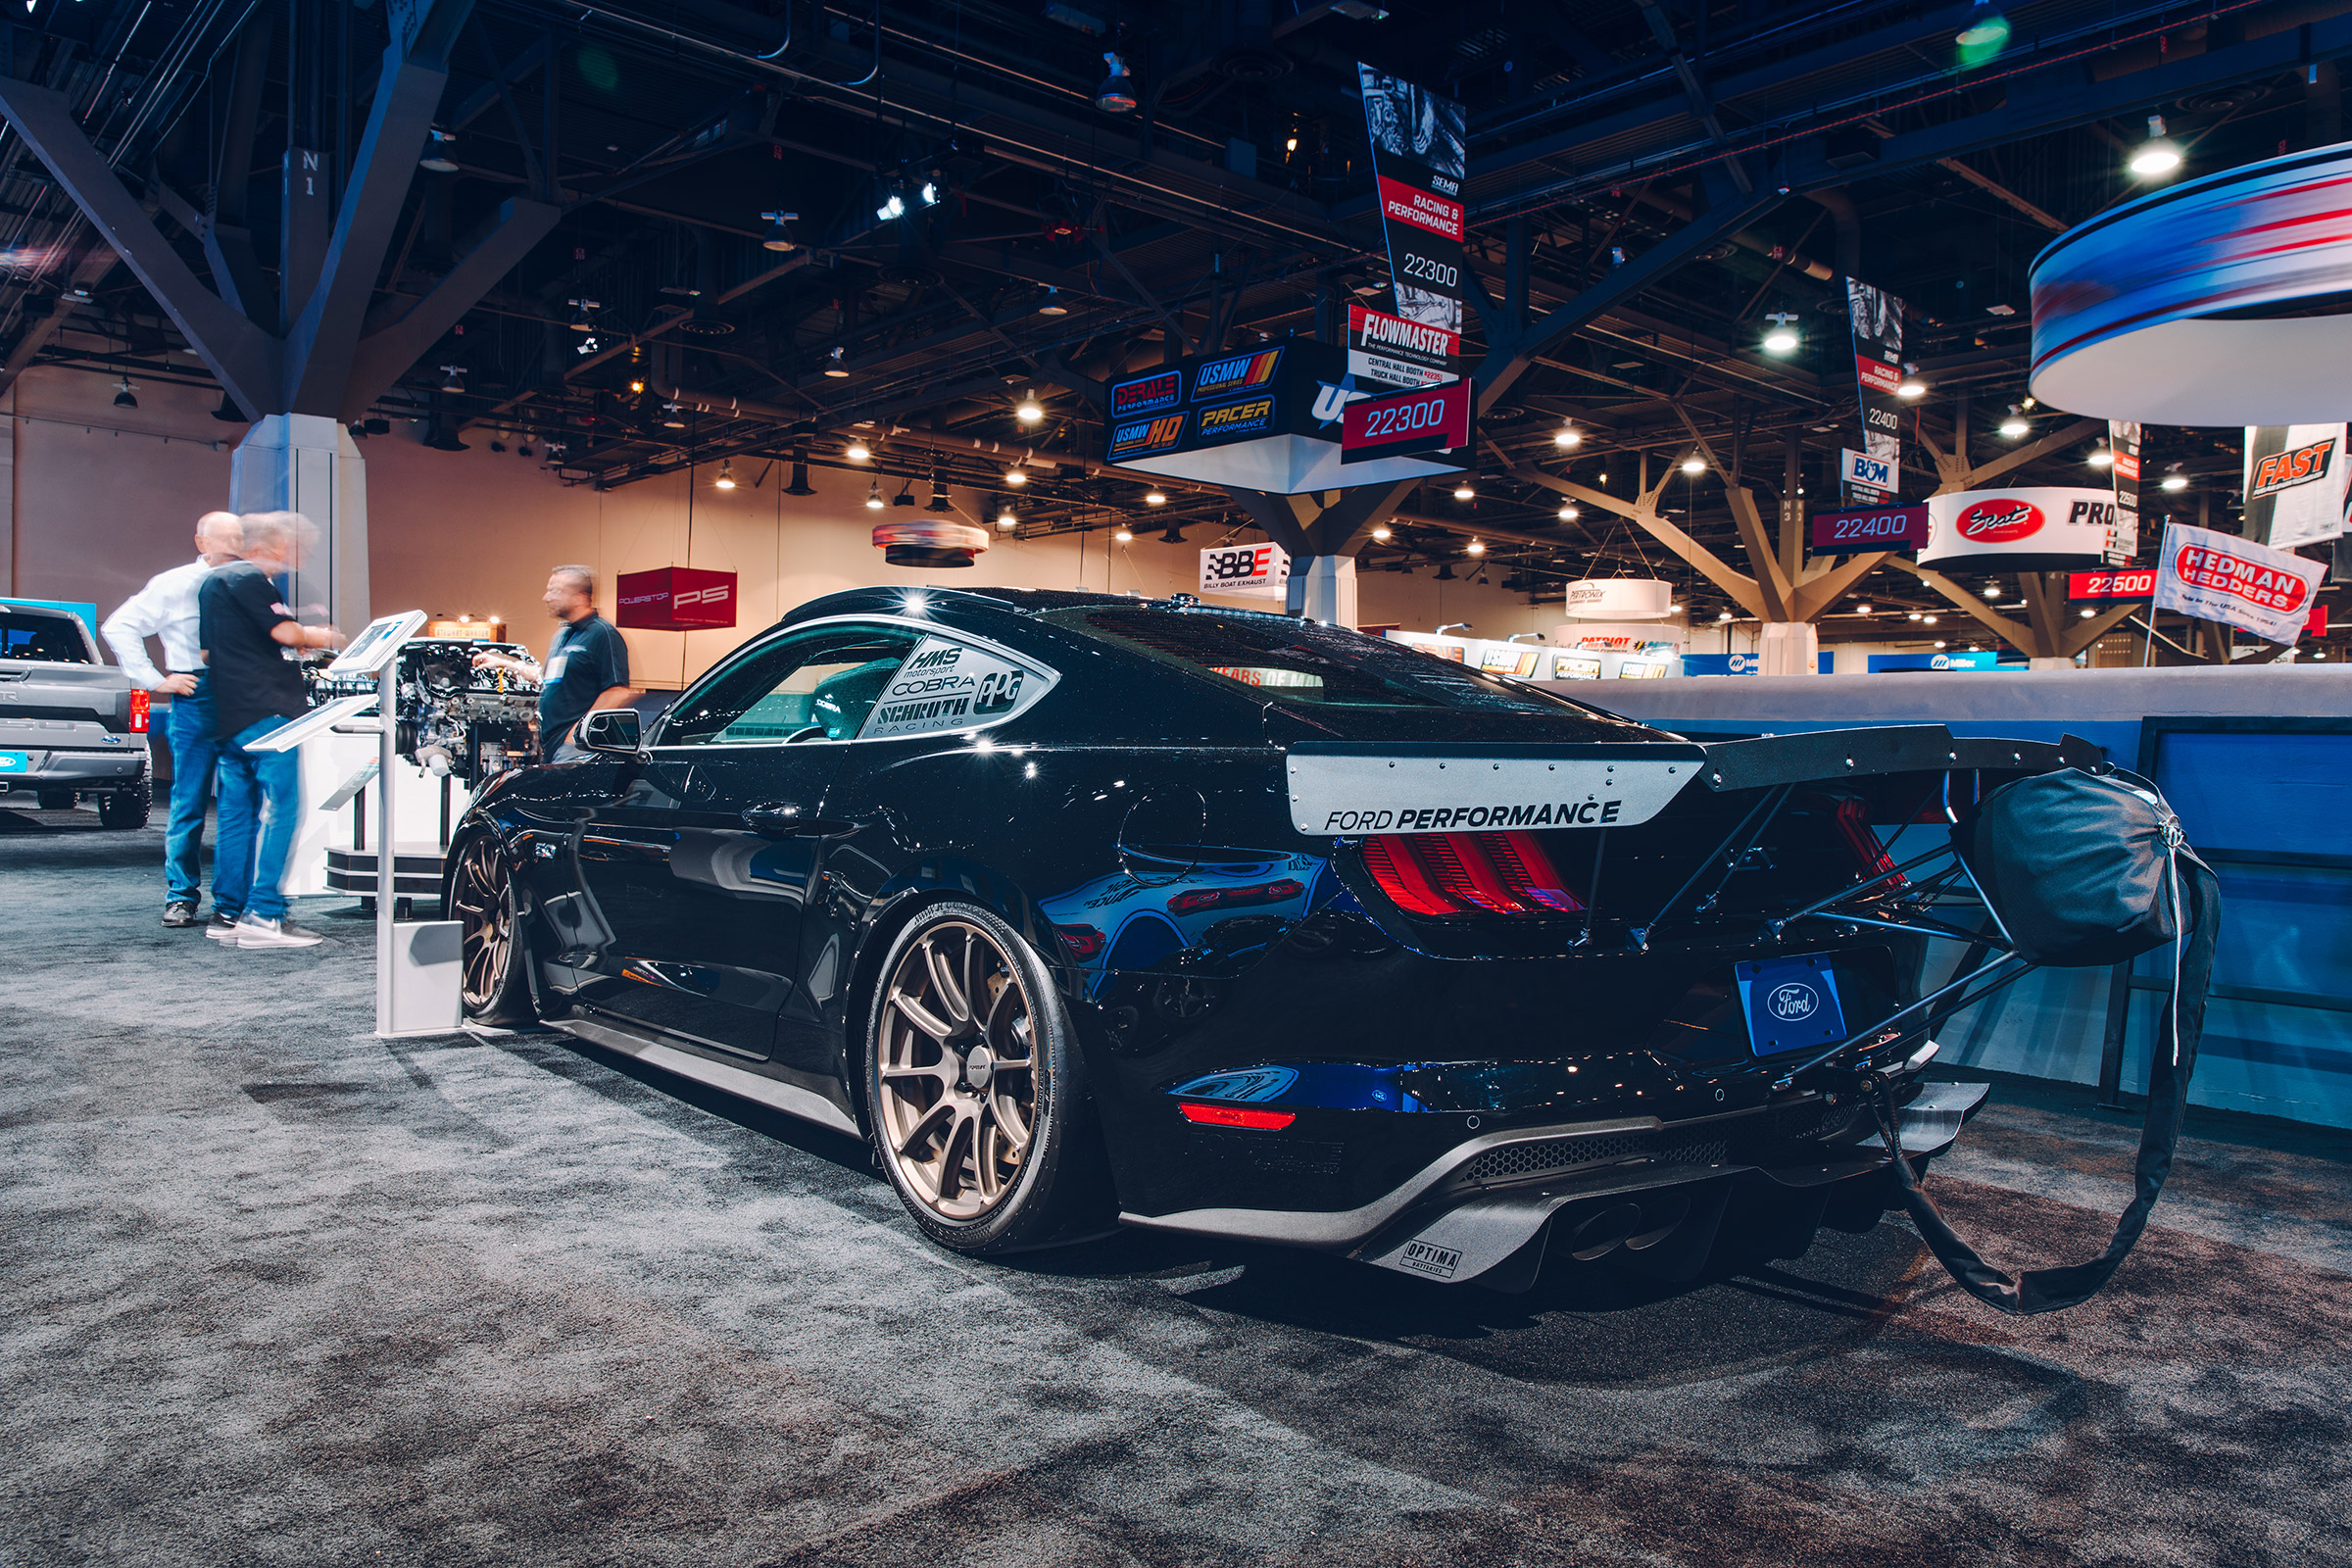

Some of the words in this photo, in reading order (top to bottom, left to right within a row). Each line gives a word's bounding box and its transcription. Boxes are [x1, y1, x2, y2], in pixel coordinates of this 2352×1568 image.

[303, 150, 318, 172] N
[306, 177, 314, 195] 1
[1432, 174, 1459, 193] SEMA
[1388, 201, 1459, 235] PERFORMANCE
[1413, 194, 1449, 217] RACING
[1451, 208, 1459, 220] &
[1403, 253, 1457, 287] 22300
[1361, 313, 1449, 357] FLOWMASTER
[1376, 344, 1404, 357] PERFORMANCE
[1404, 351, 1429, 363] TECHNOLOGY
[1200, 358, 1251, 386] USMW
[1368, 357, 1392, 369] CENTRAL
[1392, 364, 1405, 372] HALL
[1405, 366, 1424, 376] BOOTH
[1371, 368, 1389, 379] TRUCK
[1389, 373, 1401, 383] HALL
[1402, 374, 1420, 386] BOOTH
[1874, 366, 1893, 379] RACING
[1117, 376, 1175, 405] DERALE
[1861, 371, 1898, 392] PERFORMANCE
[1117, 394, 1175, 413] PERFORMANCE
[1200, 401, 1271, 427] PACER
[1115, 423, 1151, 443] USMW
[1146, 416, 1184, 444] HD
[1200, 417, 1267, 436] PERFORMANCE
[1364, 399, 1445, 438] 22300
[1869, 408, 1898, 429] 22400
[1853, 458, 1889, 483] B&M
[2256, 442, 2333, 489] FAST
[2069, 500, 2118, 524] PRO
[1834, 514, 1907, 539] 22400
[1217, 547, 1272, 579] BBE
[2186, 550, 2296, 595] HEDMAN
[2086, 574, 2151, 594] 22500
[2183, 566, 2288, 610] HEDDERS
[618, 592, 669, 605] POWERSTOP
[674, 585, 729, 610] PS
[2220, 603, 2236, 612] USA
[1581, 636, 1631, 649] PATRIOT
[907, 647, 963, 670] HMS
[904, 664, 956, 679] motorsport
[892, 675, 976, 697] COBRA
[874, 717, 963, 735] RACING
[1324, 809, 1393, 831] FORD
[1396, 799, 1622, 830] PERFORMANCE
[1778, 988, 1811, 1016] Ford
[1407, 1243, 1457, 1267] OPTIMA
[1412, 1261, 1443, 1274] BATTERIES
